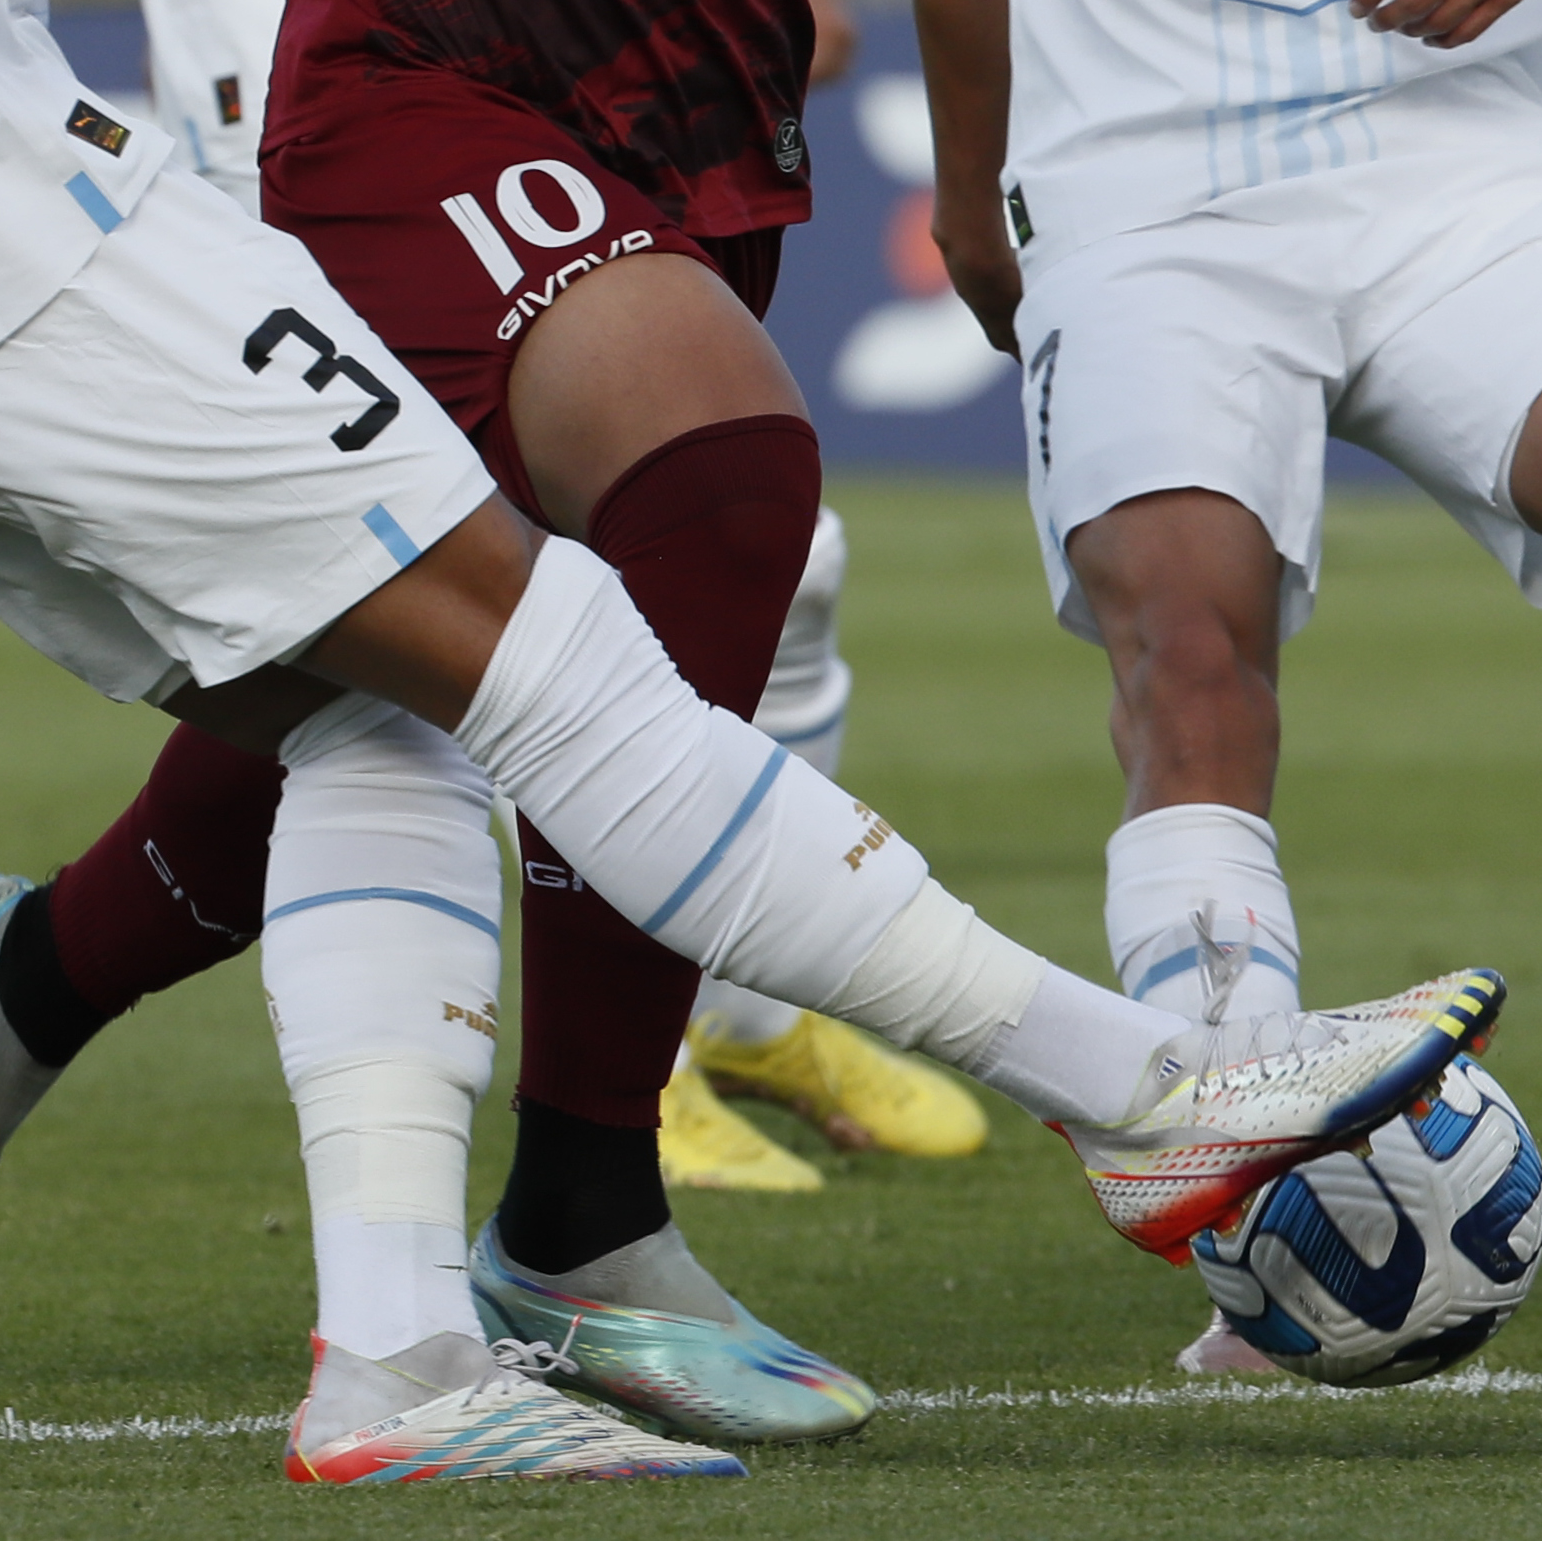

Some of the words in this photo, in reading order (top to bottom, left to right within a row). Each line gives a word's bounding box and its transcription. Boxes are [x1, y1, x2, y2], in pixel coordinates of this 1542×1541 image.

[439, 158, 607, 296] 10
[242, 306, 401, 452] 3
[842, 818, 893, 872] PUM
[441, 1000, 497, 1041] PUM
